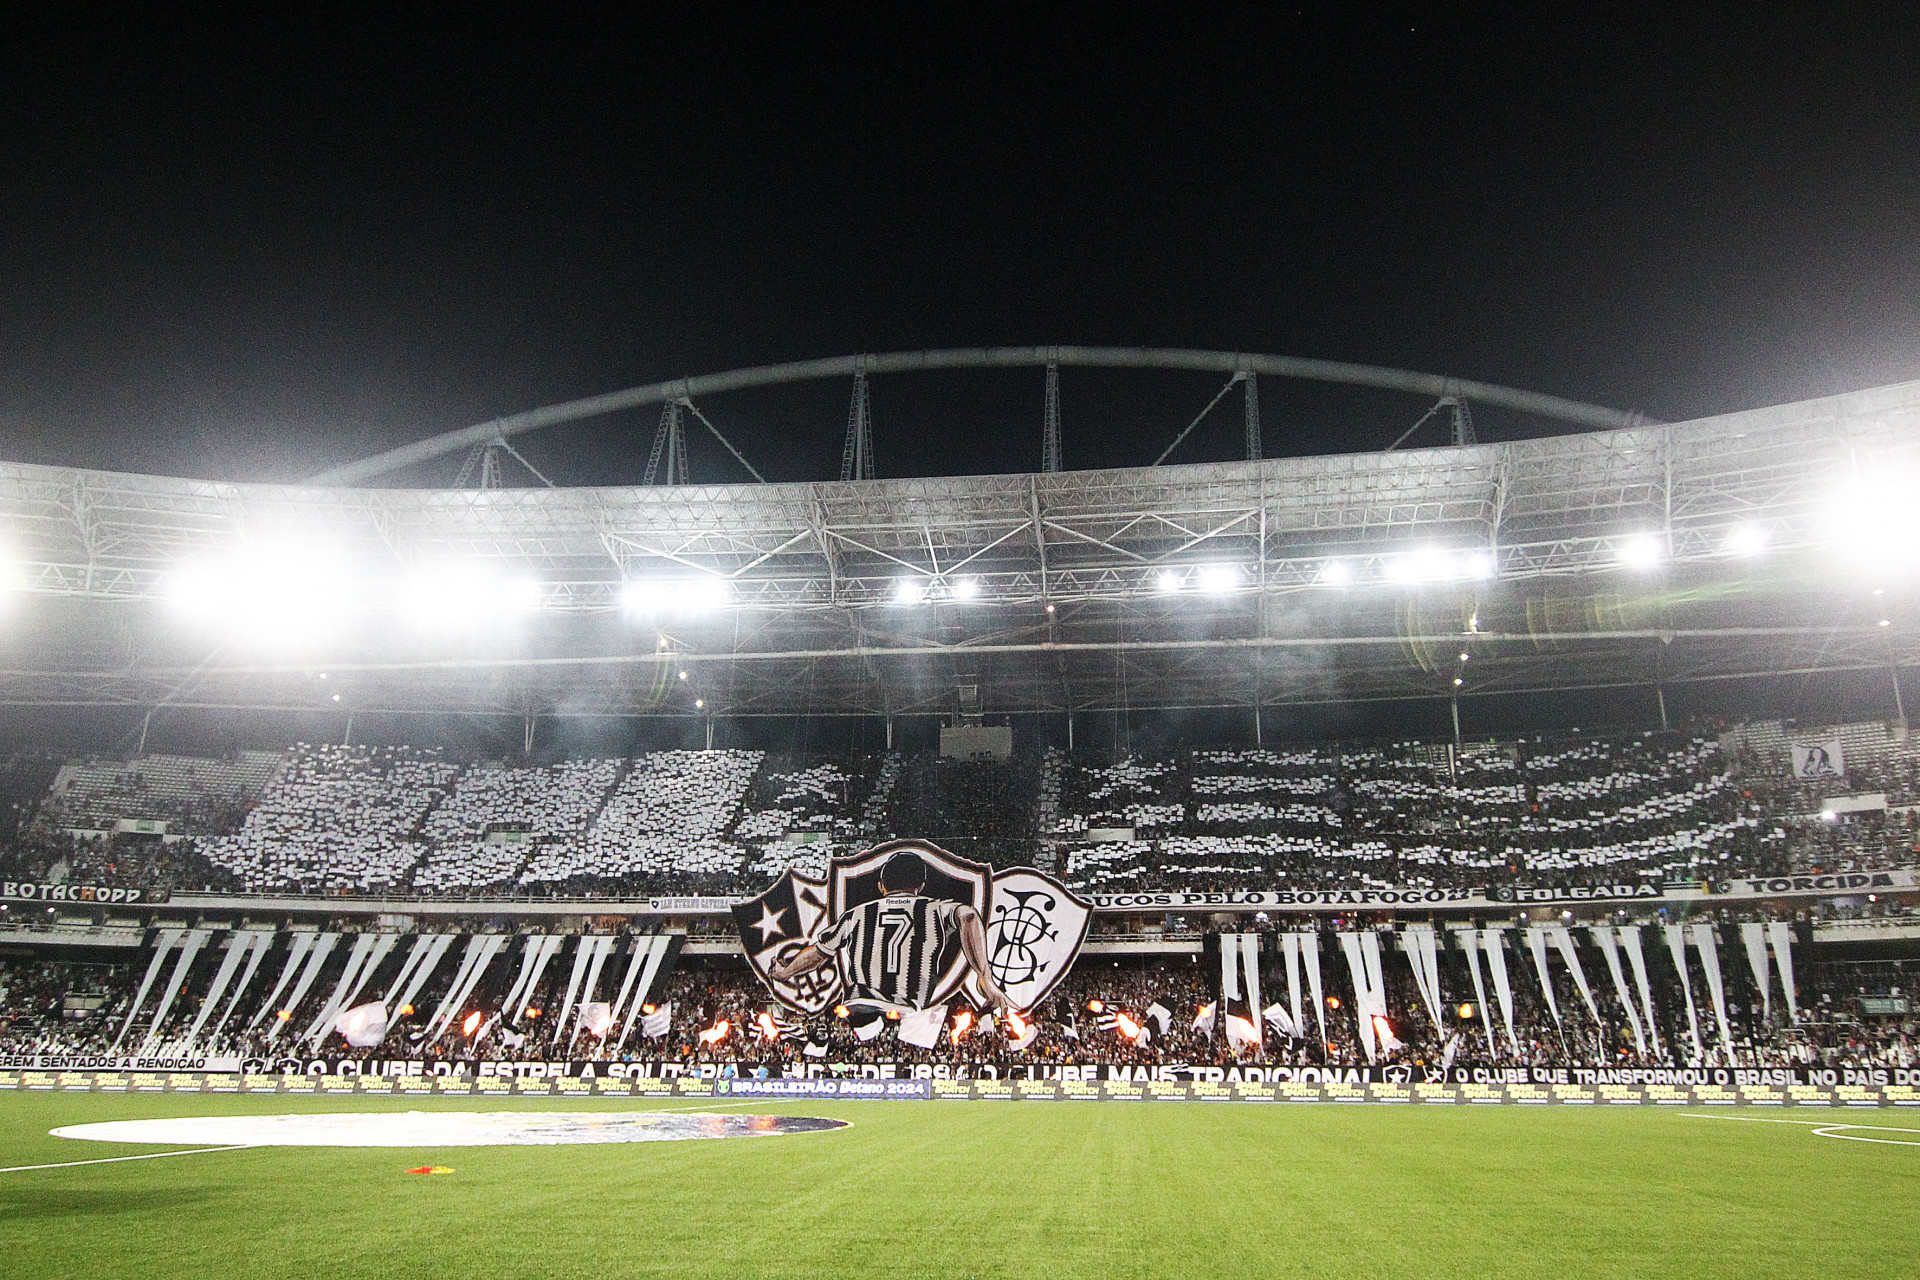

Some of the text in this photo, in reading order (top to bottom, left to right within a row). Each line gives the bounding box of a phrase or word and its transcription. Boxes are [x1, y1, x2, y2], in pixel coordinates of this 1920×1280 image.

[1746, 873, 1894, 893] TORCIDA
[1182, 892, 1265, 905] PELO
[1275, 889, 1445, 904] BOTAFOGO
[1517, 884, 1658, 901] FOLGADA
[880, 911, 914, 974] 7
[40, 1056, 117, 1068] SENTADOS
[122, 1058, 131, 1068] A
[336, 1060, 425, 1077] CLUBE
[433, 1061, 467, 1077] DA
[607, 1062, 740, 1079] SOLITRIA
[1455, 1068, 1469, 1083] O
[1473, 1068, 1529, 1084] CLUBE
[1533, 1068, 1569, 1084] QUE
[1573, 1069, 1709, 1085] TRANSFORMOU
[1715, 1069, 1729, 1085] O
[1734, 1069, 1803, 1086] BRASIL
[1808, 1069, 1838, 1086] NO
[732, 1080, 925, 1094] BRASILEIRÃO Betano 2024
